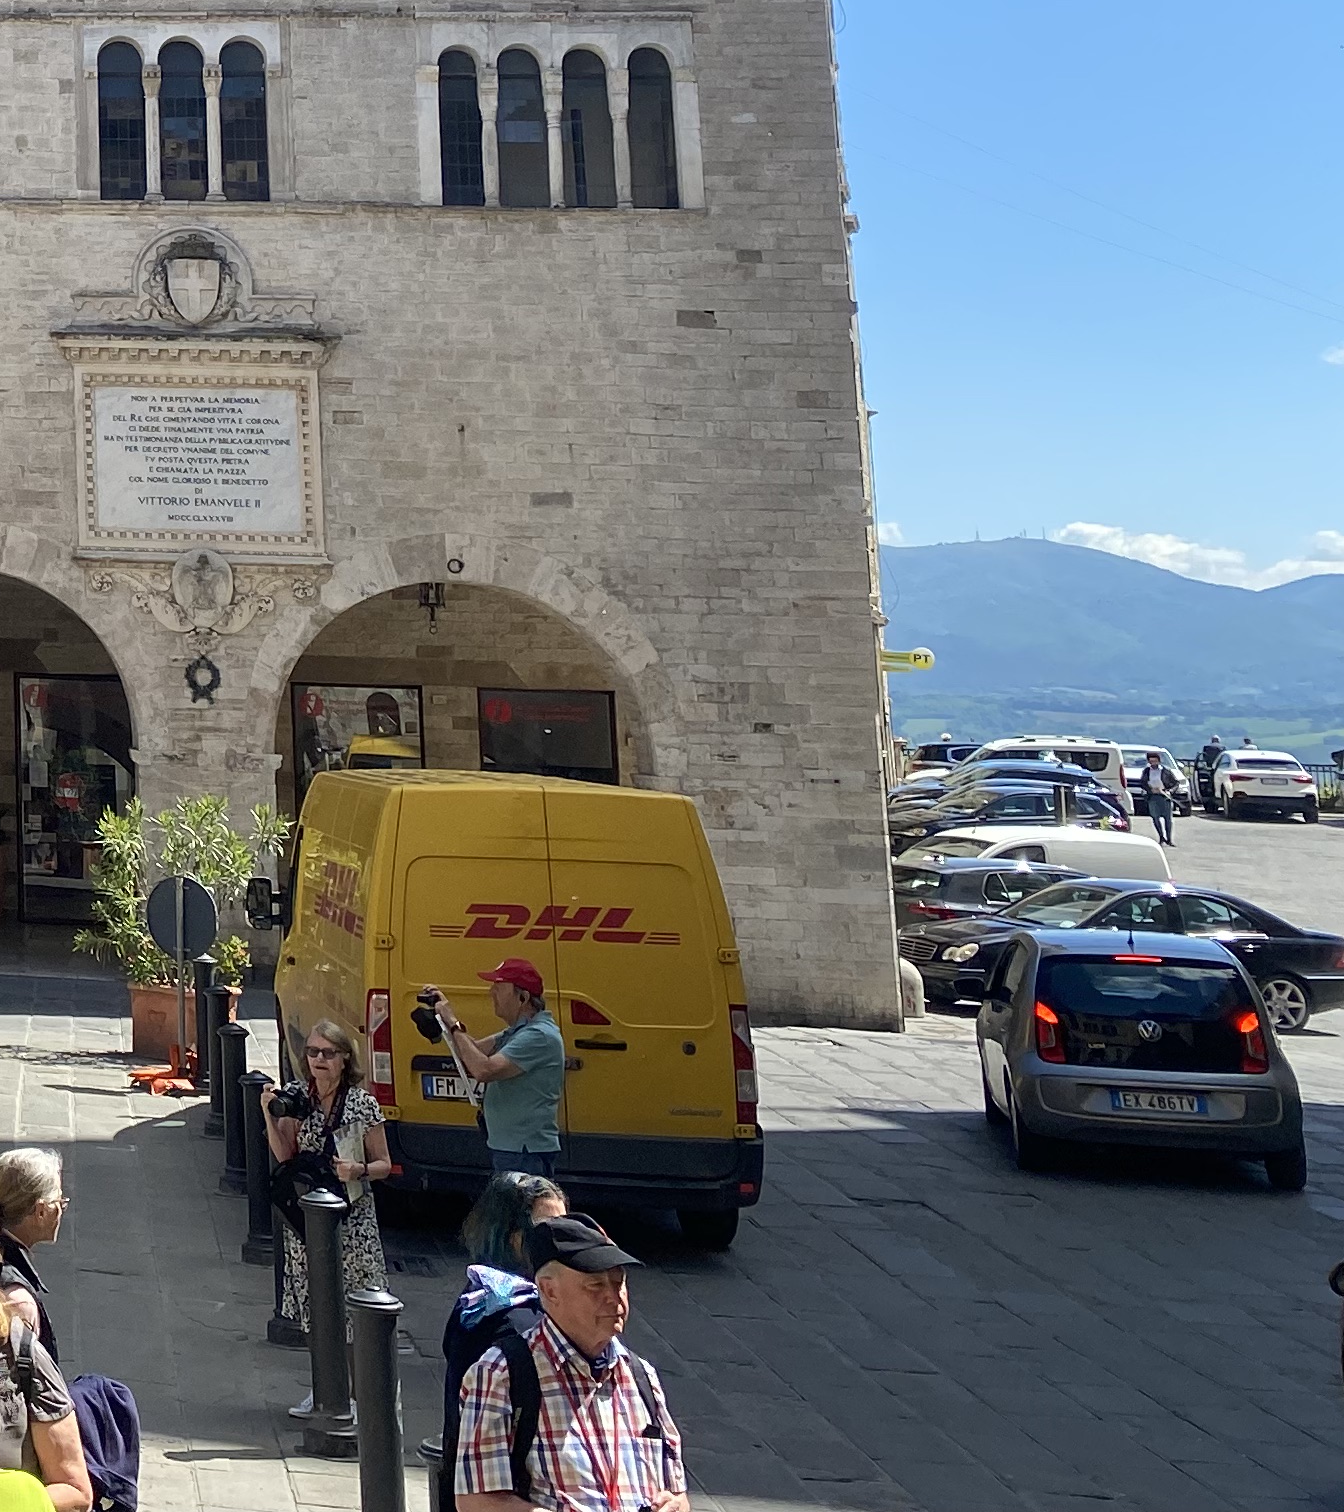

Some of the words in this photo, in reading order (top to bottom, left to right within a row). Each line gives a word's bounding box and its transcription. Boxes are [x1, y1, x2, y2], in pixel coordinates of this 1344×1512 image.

[151, 395, 157, 403] A
[208, 396, 220, 404] LA
[162, 416, 216, 424] CIMENTANDO
[216, 417, 237, 425] VITA
[124, 445, 140, 453] PER
[142, 446, 179, 454] DECRETO
[220, 447, 236, 455] DEL
[236, 448, 271, 456] COMVNE
[158, 456, 185, 464] POSTA
[186, 457, 219, 465] QVESTA
[202, 467, 214, 475] LA
[216, 468, 247, 476] PIAZZA
[128, 475, 145, 483] COL
[146, 476, 170, 484] NOME
[221, 478, 269, 486] BENEDETTO
[194, 487, 203, 495] DI
[137, 496, 191, 506] VITTORIO
[194, 497, 252, 508] EMANVELE
[254, 499, 261, 508] II
[913, 653, 932, 664] PT
[462, 903, 648, 944] DHL
[435, 1077, 456, 1096] FM
[1122, 1093, 1142, 1108] EX
